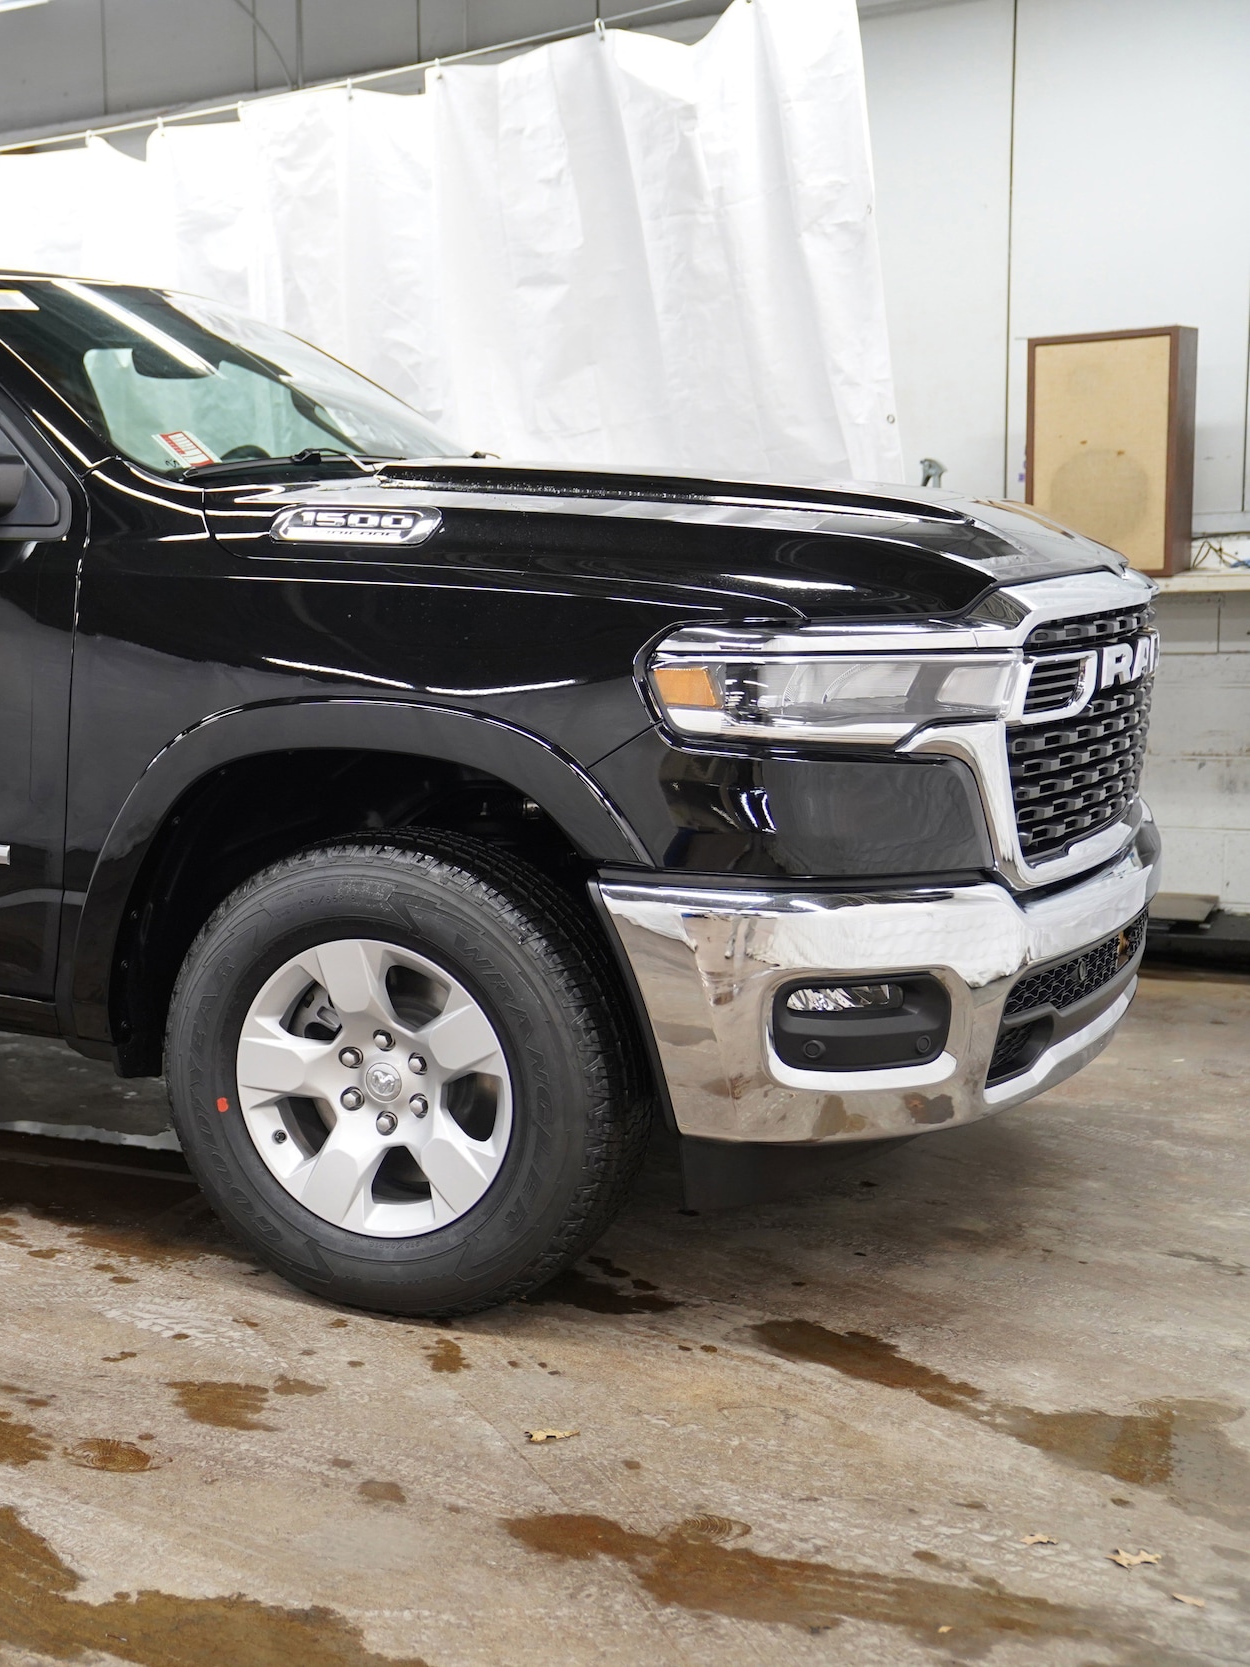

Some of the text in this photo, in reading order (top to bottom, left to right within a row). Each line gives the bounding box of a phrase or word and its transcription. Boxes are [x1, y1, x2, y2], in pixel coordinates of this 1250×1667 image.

[301, 511, 414, 529] 1500
[189, 954, 282, 1242] GOODYEAR
[454, 932, 555, 1233] WRANGLER
